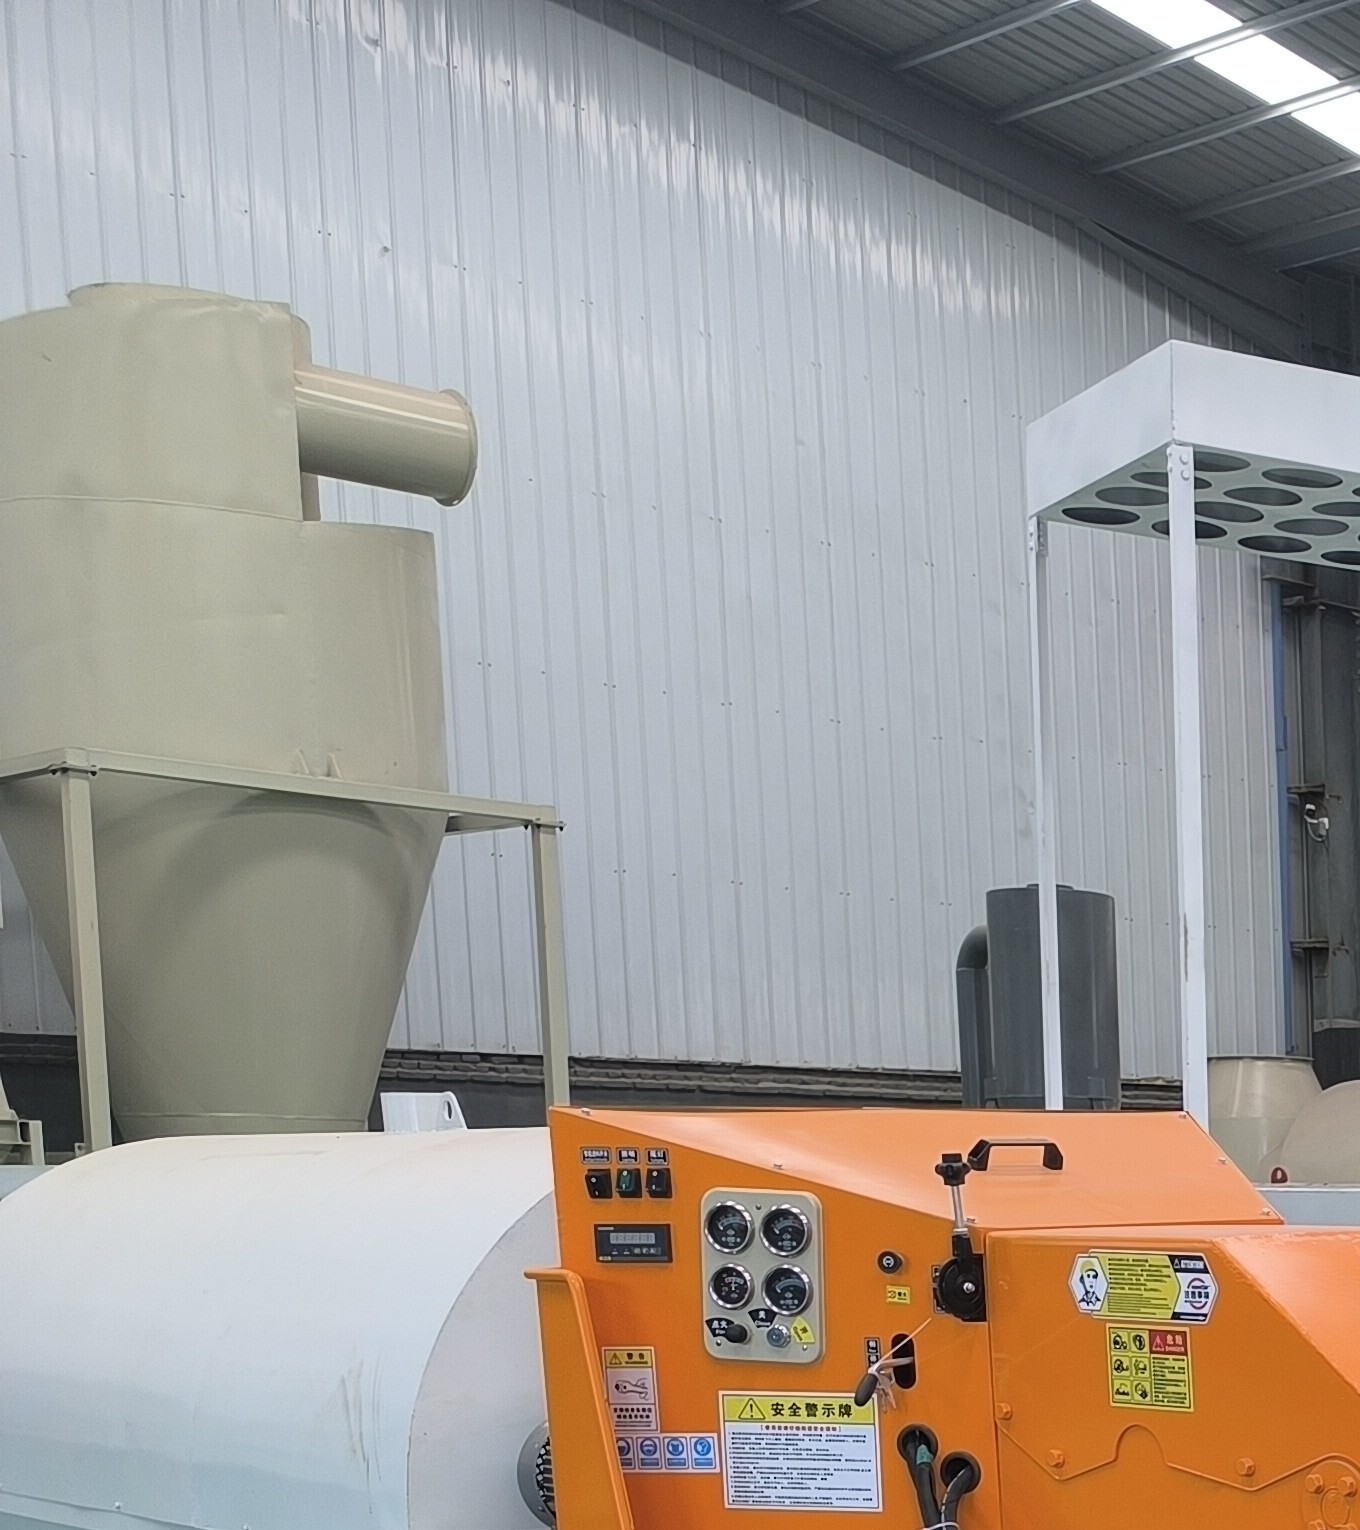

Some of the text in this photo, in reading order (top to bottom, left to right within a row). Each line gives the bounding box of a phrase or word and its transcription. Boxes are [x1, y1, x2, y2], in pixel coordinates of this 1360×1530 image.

[770, 1402, 853, 1419] 安全警示牌
